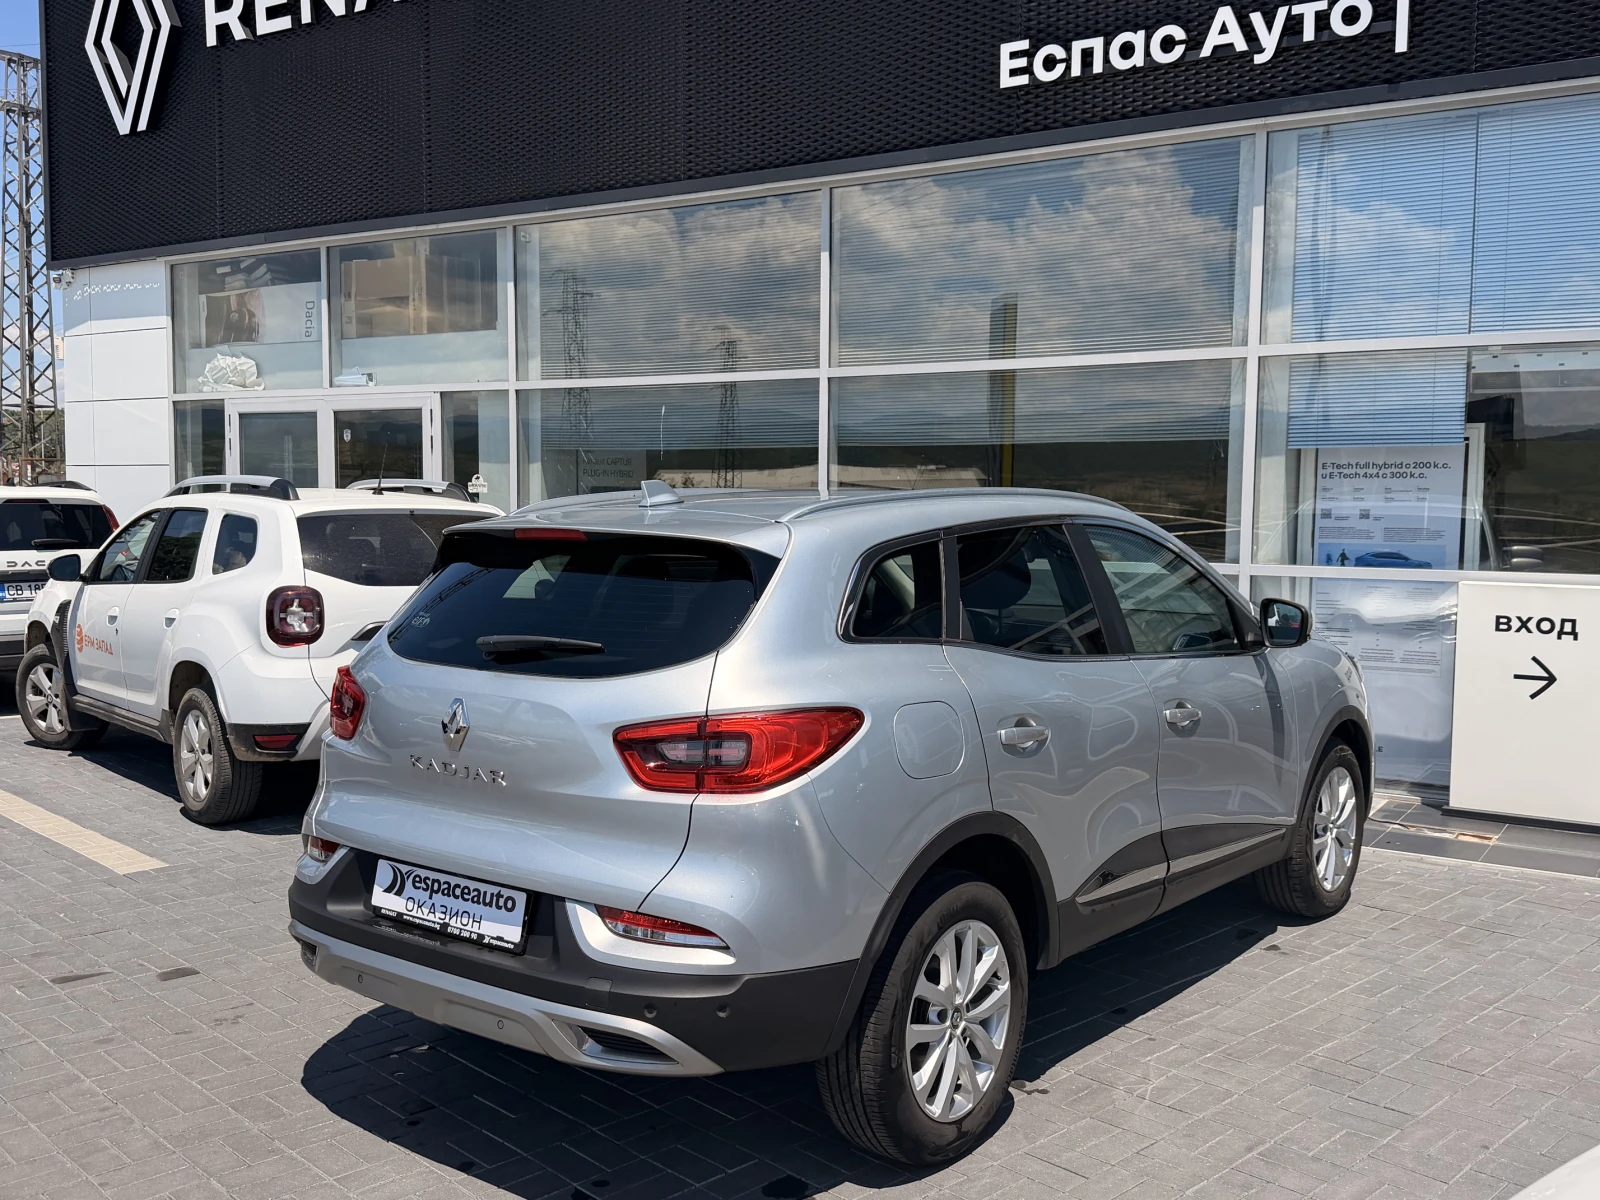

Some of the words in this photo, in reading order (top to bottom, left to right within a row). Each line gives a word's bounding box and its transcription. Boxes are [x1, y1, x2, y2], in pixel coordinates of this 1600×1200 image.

[1000, 24, 1187, 89] Еспас
[1199, 0, 1373, 64] Ауто
[304, 300, 315, 338] Dacia
[606, 457, 632, 466] CAPTUR
[1321, 461, 1354, 470] E-Tech
[1355, 461, 1371, 470] full
[1371, 461, 1404, 471] hybrid
[1412, 461, 1432, 469] 200
[582, 468, 609, 477] PLUG-IN
[610, 469, 634, 478] HYBRID
[1329, 471, 1360, 479] E-Tech
[1390, 471, 1408, 479] 300
[6, 560, 46, 568] DAC
[84, 634, 95, 649] ЕРМ
[95, 637, 114, 656] ЗАПАД
[410, 753, 507, 786] KADJAR
[411, 872, 517, 913] espaceauto
[405, 896, 483, 931] ОКАЗИОН
[460, 929, 470, 938] 200
[470, 932, 478, 940] 90
